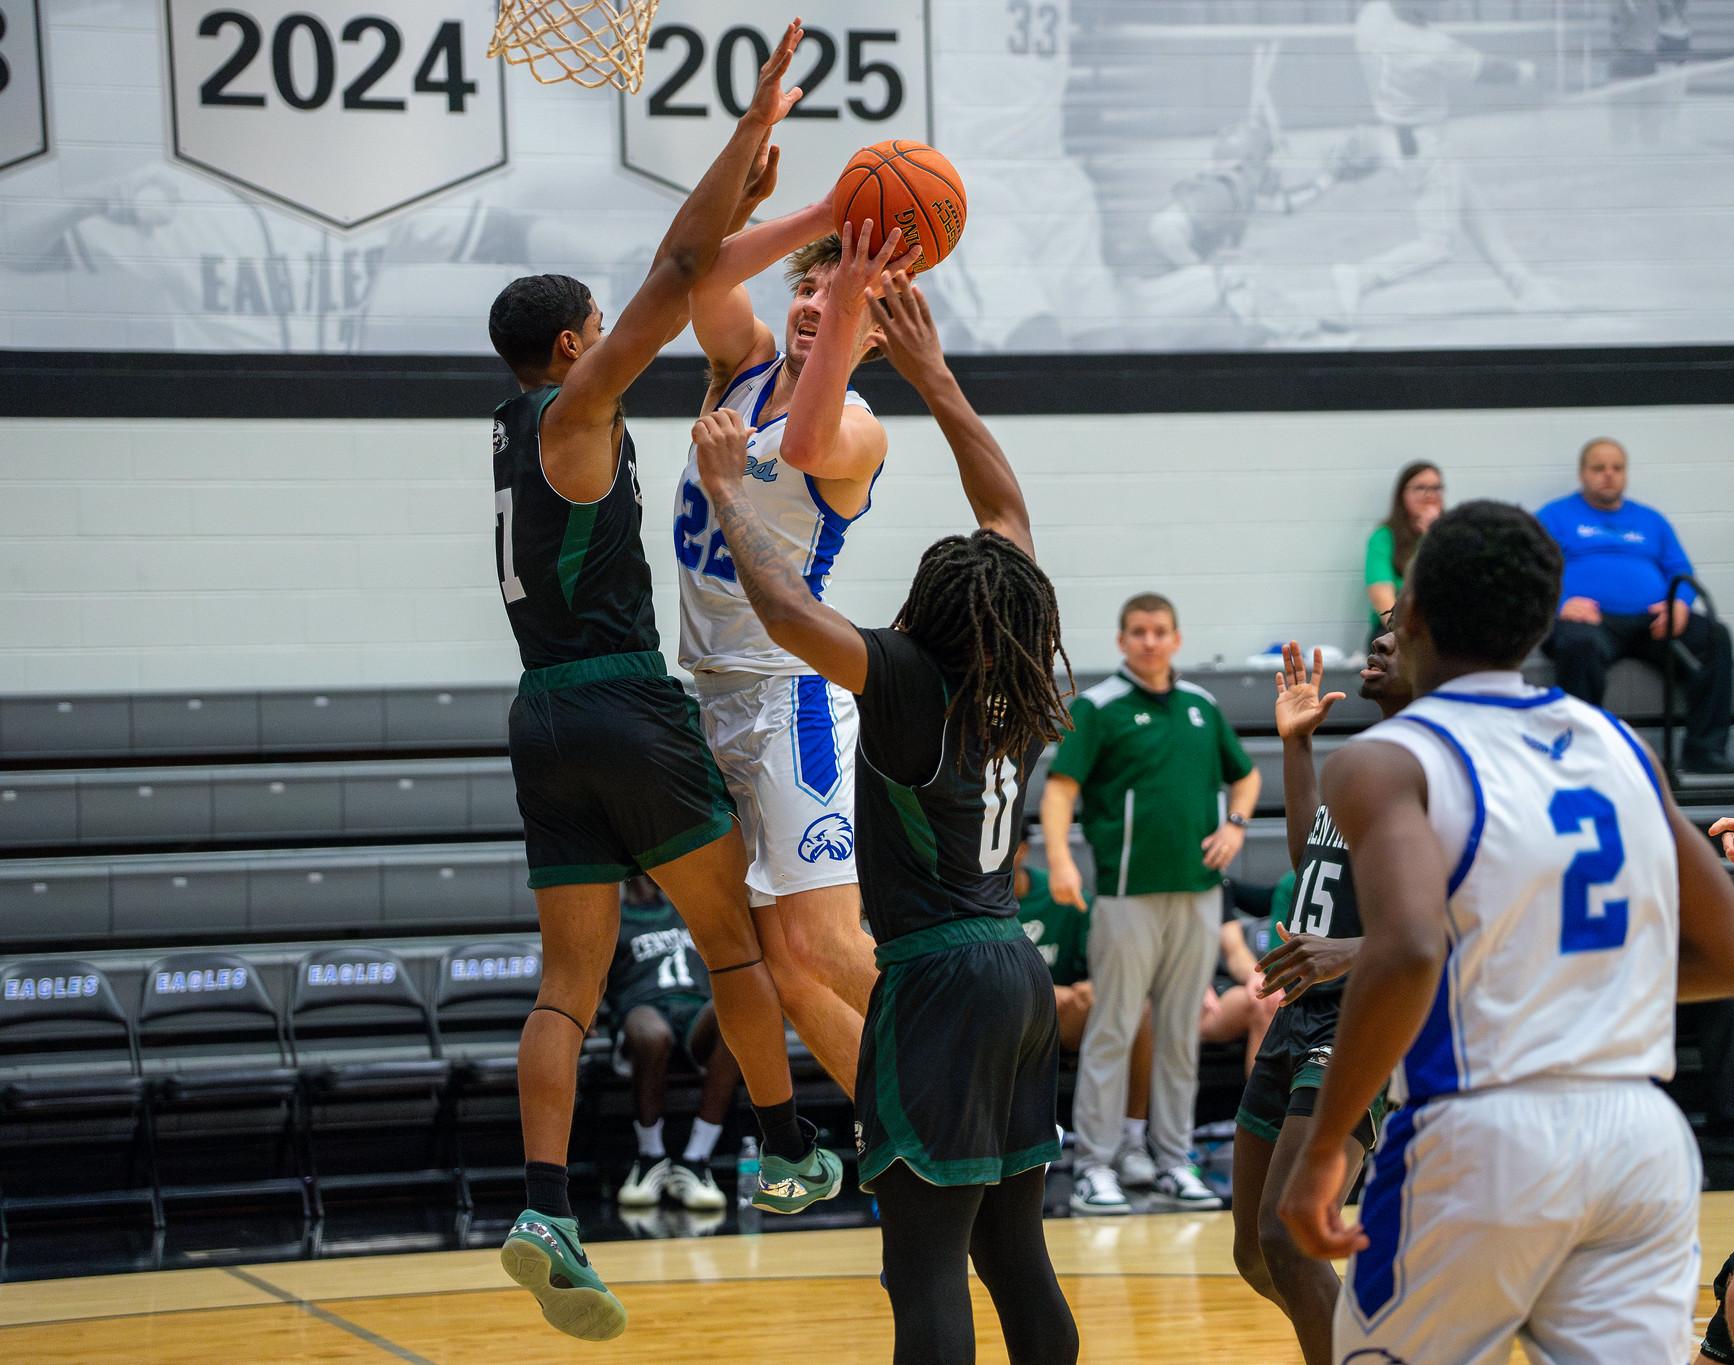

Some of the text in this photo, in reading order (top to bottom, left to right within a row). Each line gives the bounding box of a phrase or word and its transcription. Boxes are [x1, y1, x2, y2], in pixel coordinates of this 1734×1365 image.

[198, 9, 477, 113] 2024
[647, 24, 904, 121] 2025
[674, 479, 737, 583] 22
[979, 754, 1019, 874] 0
[1289, 859, 1342, 938] 15
[1547, 785, 1629, 955] 2
[4, 974, 99, 1000] EAGLES
[155, 967, 248, 994] EAGLES
[307, 962, 397, 986] EAGLES
[451, 956, 538, 981] EAGLES
[658, 944, 695, 989] 11
